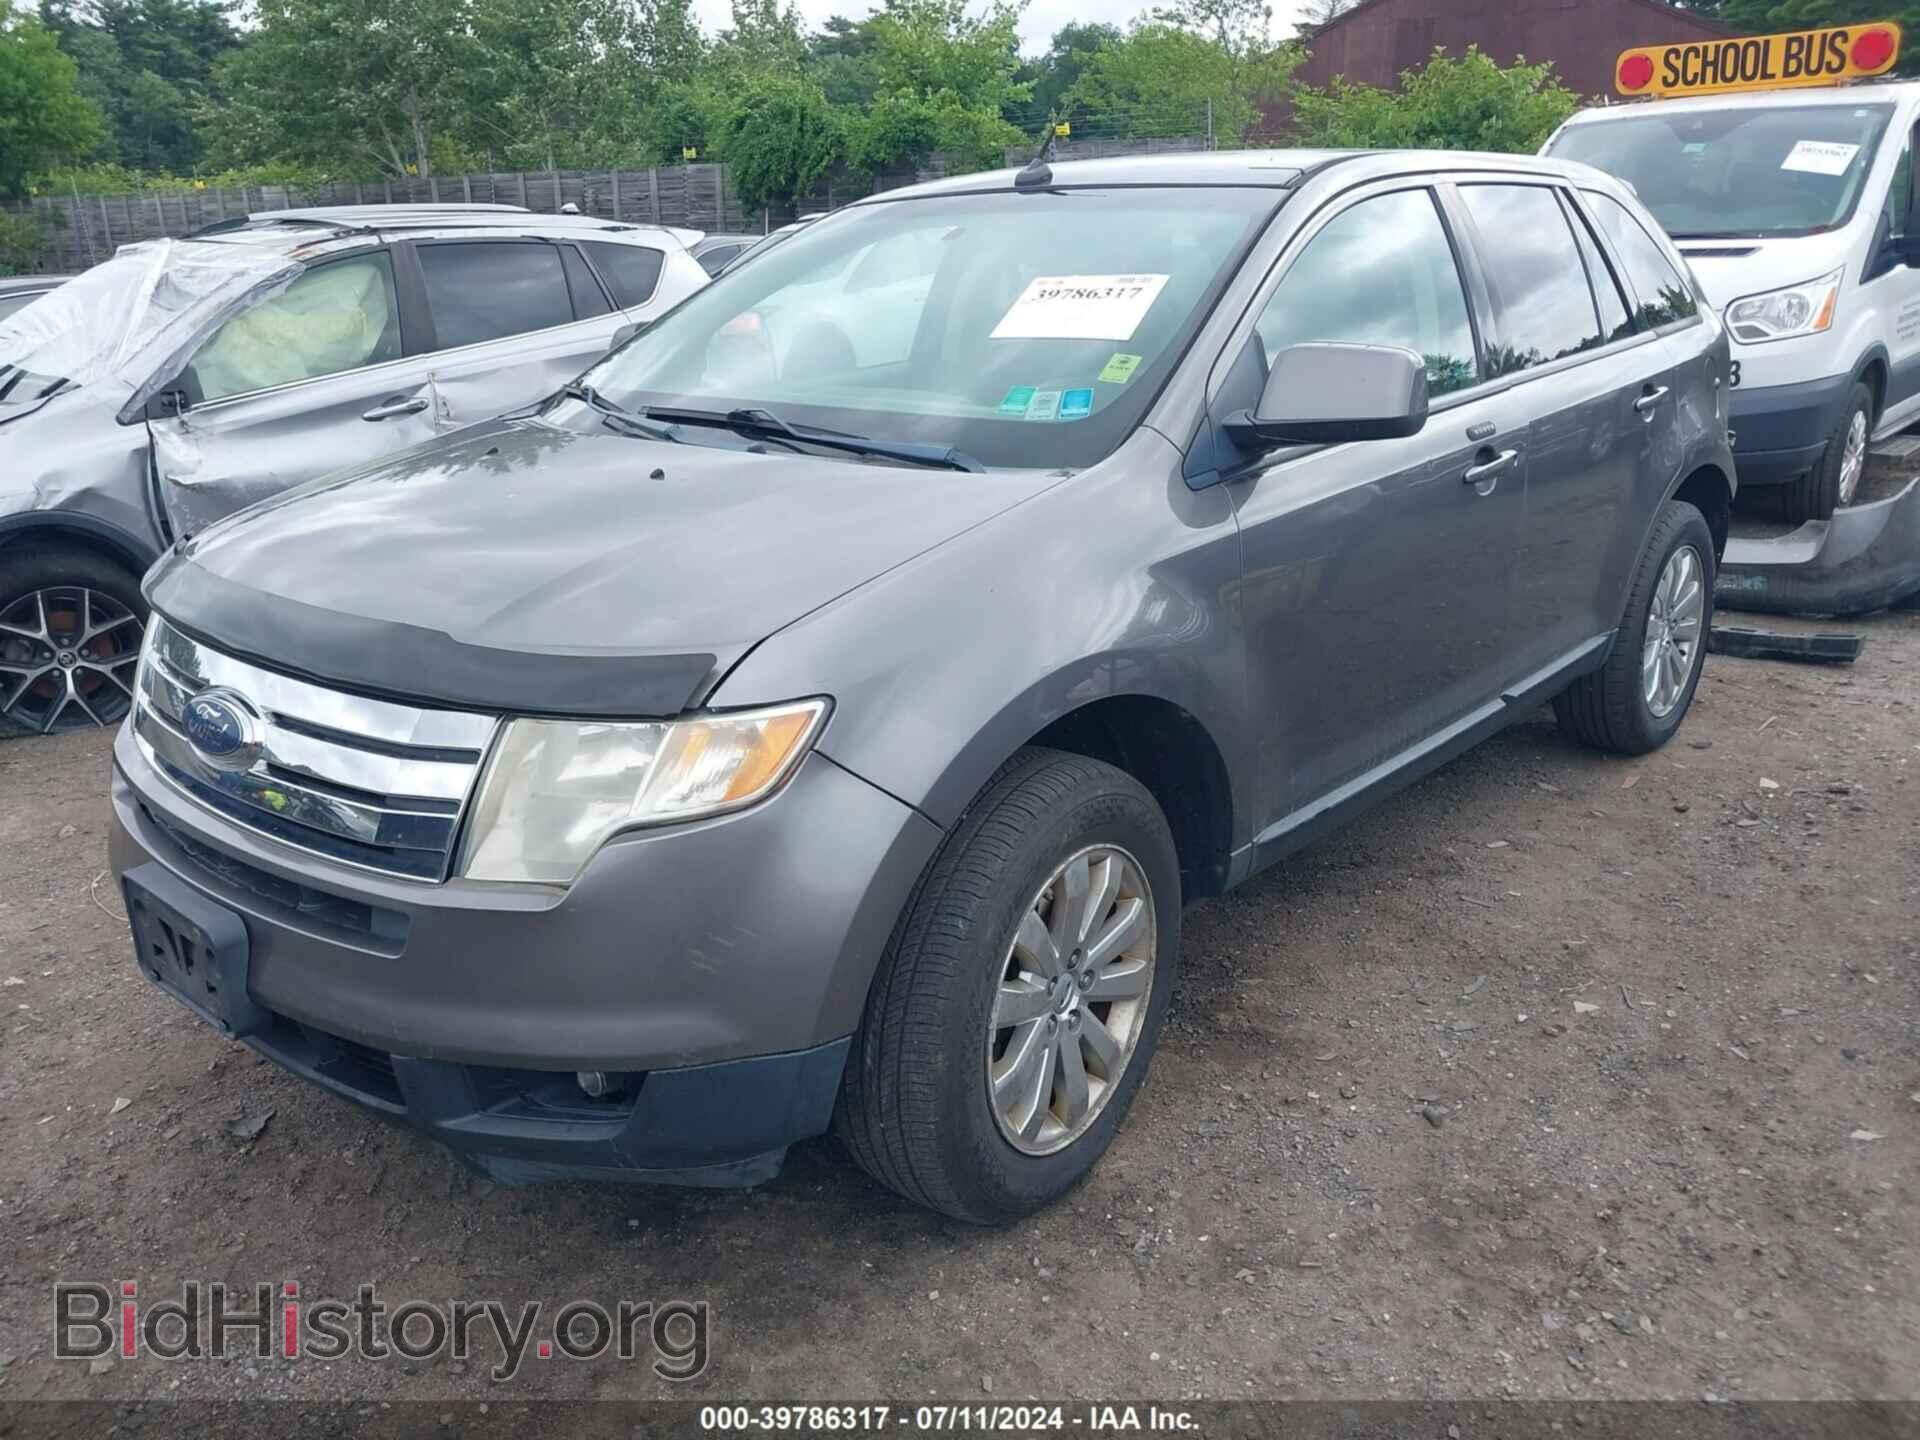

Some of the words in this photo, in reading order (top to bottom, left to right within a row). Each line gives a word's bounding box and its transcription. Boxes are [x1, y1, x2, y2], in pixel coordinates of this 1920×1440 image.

[1661, 39, 1776, 88] SCHOOL
[1782, 30, 1849, 78] BUS
[1031, 287, 1144, 302] 39786317
